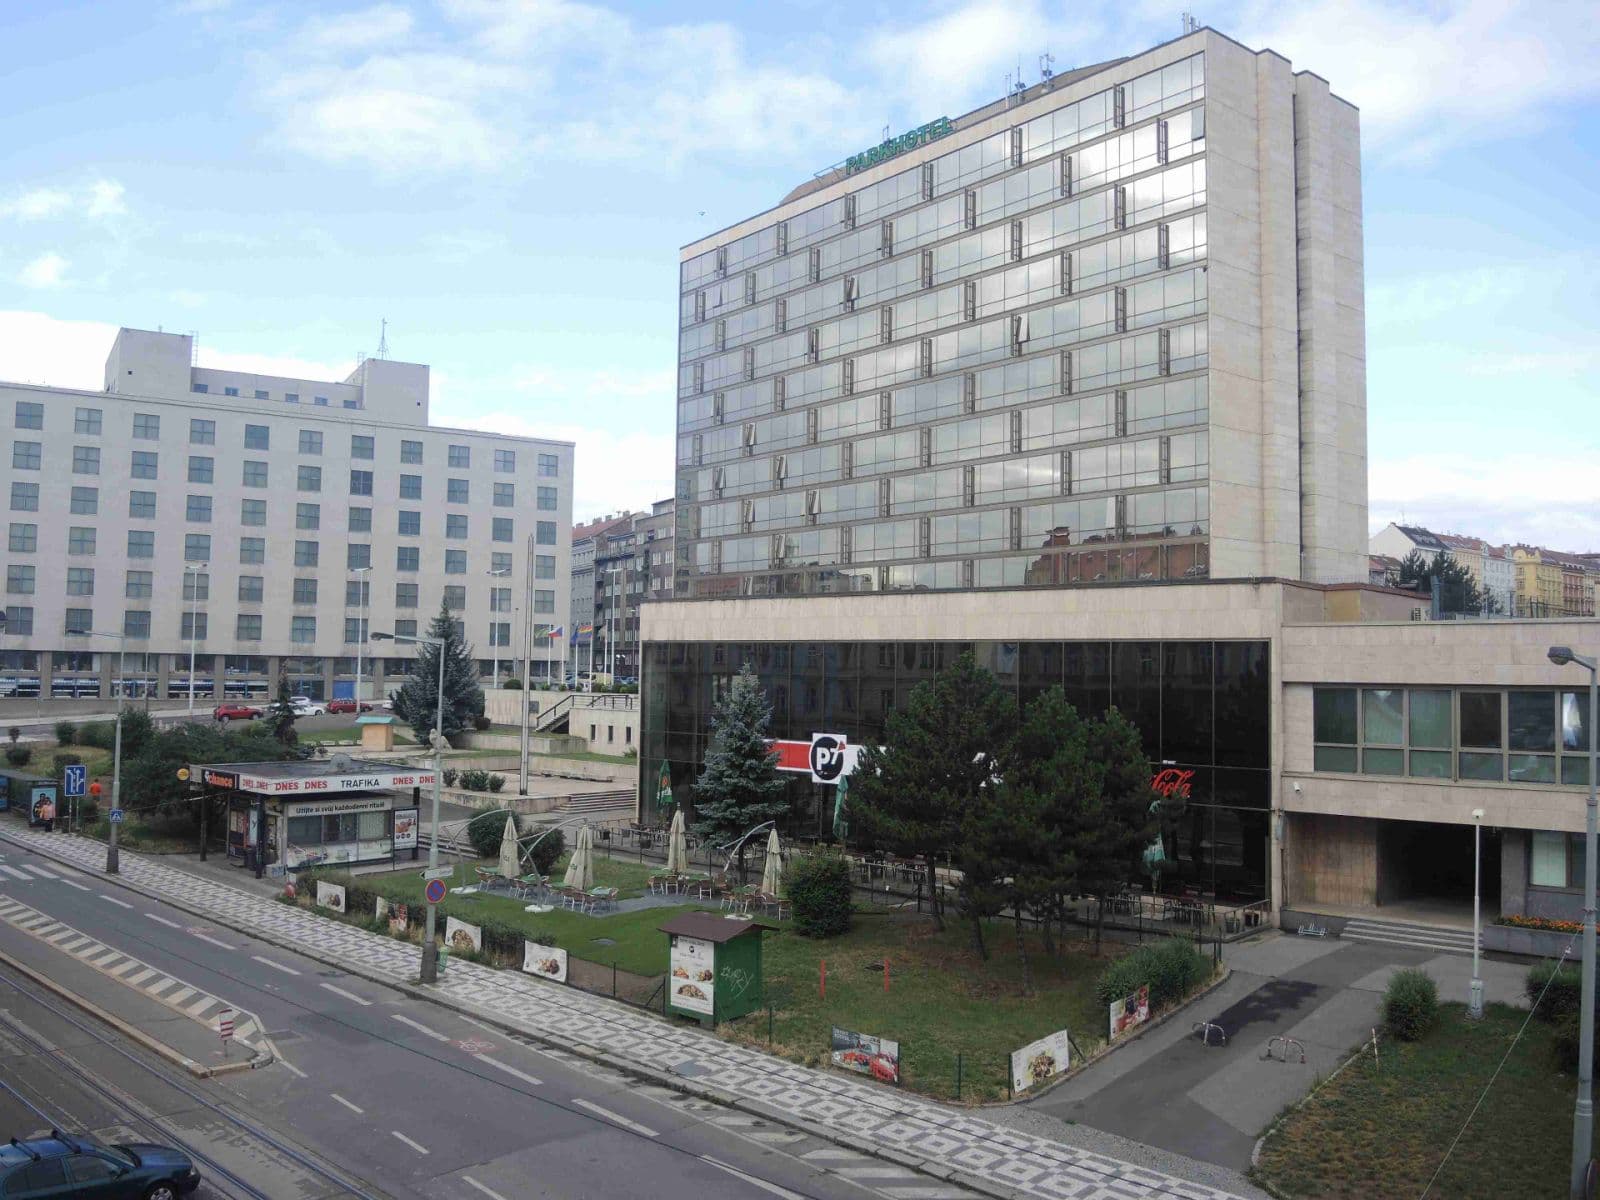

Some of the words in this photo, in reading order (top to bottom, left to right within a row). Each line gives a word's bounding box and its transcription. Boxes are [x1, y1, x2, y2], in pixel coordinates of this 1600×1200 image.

[845, 116, 954, 175] PARKHOTEL
[275, 781, 299, 791] DNES
[304, 780, 328, 790] DNES
[340, 779, 380, 788] TRAFIKA
[392, 776, 414, 785] DNES
[419, 776, 435, 784] DNE
